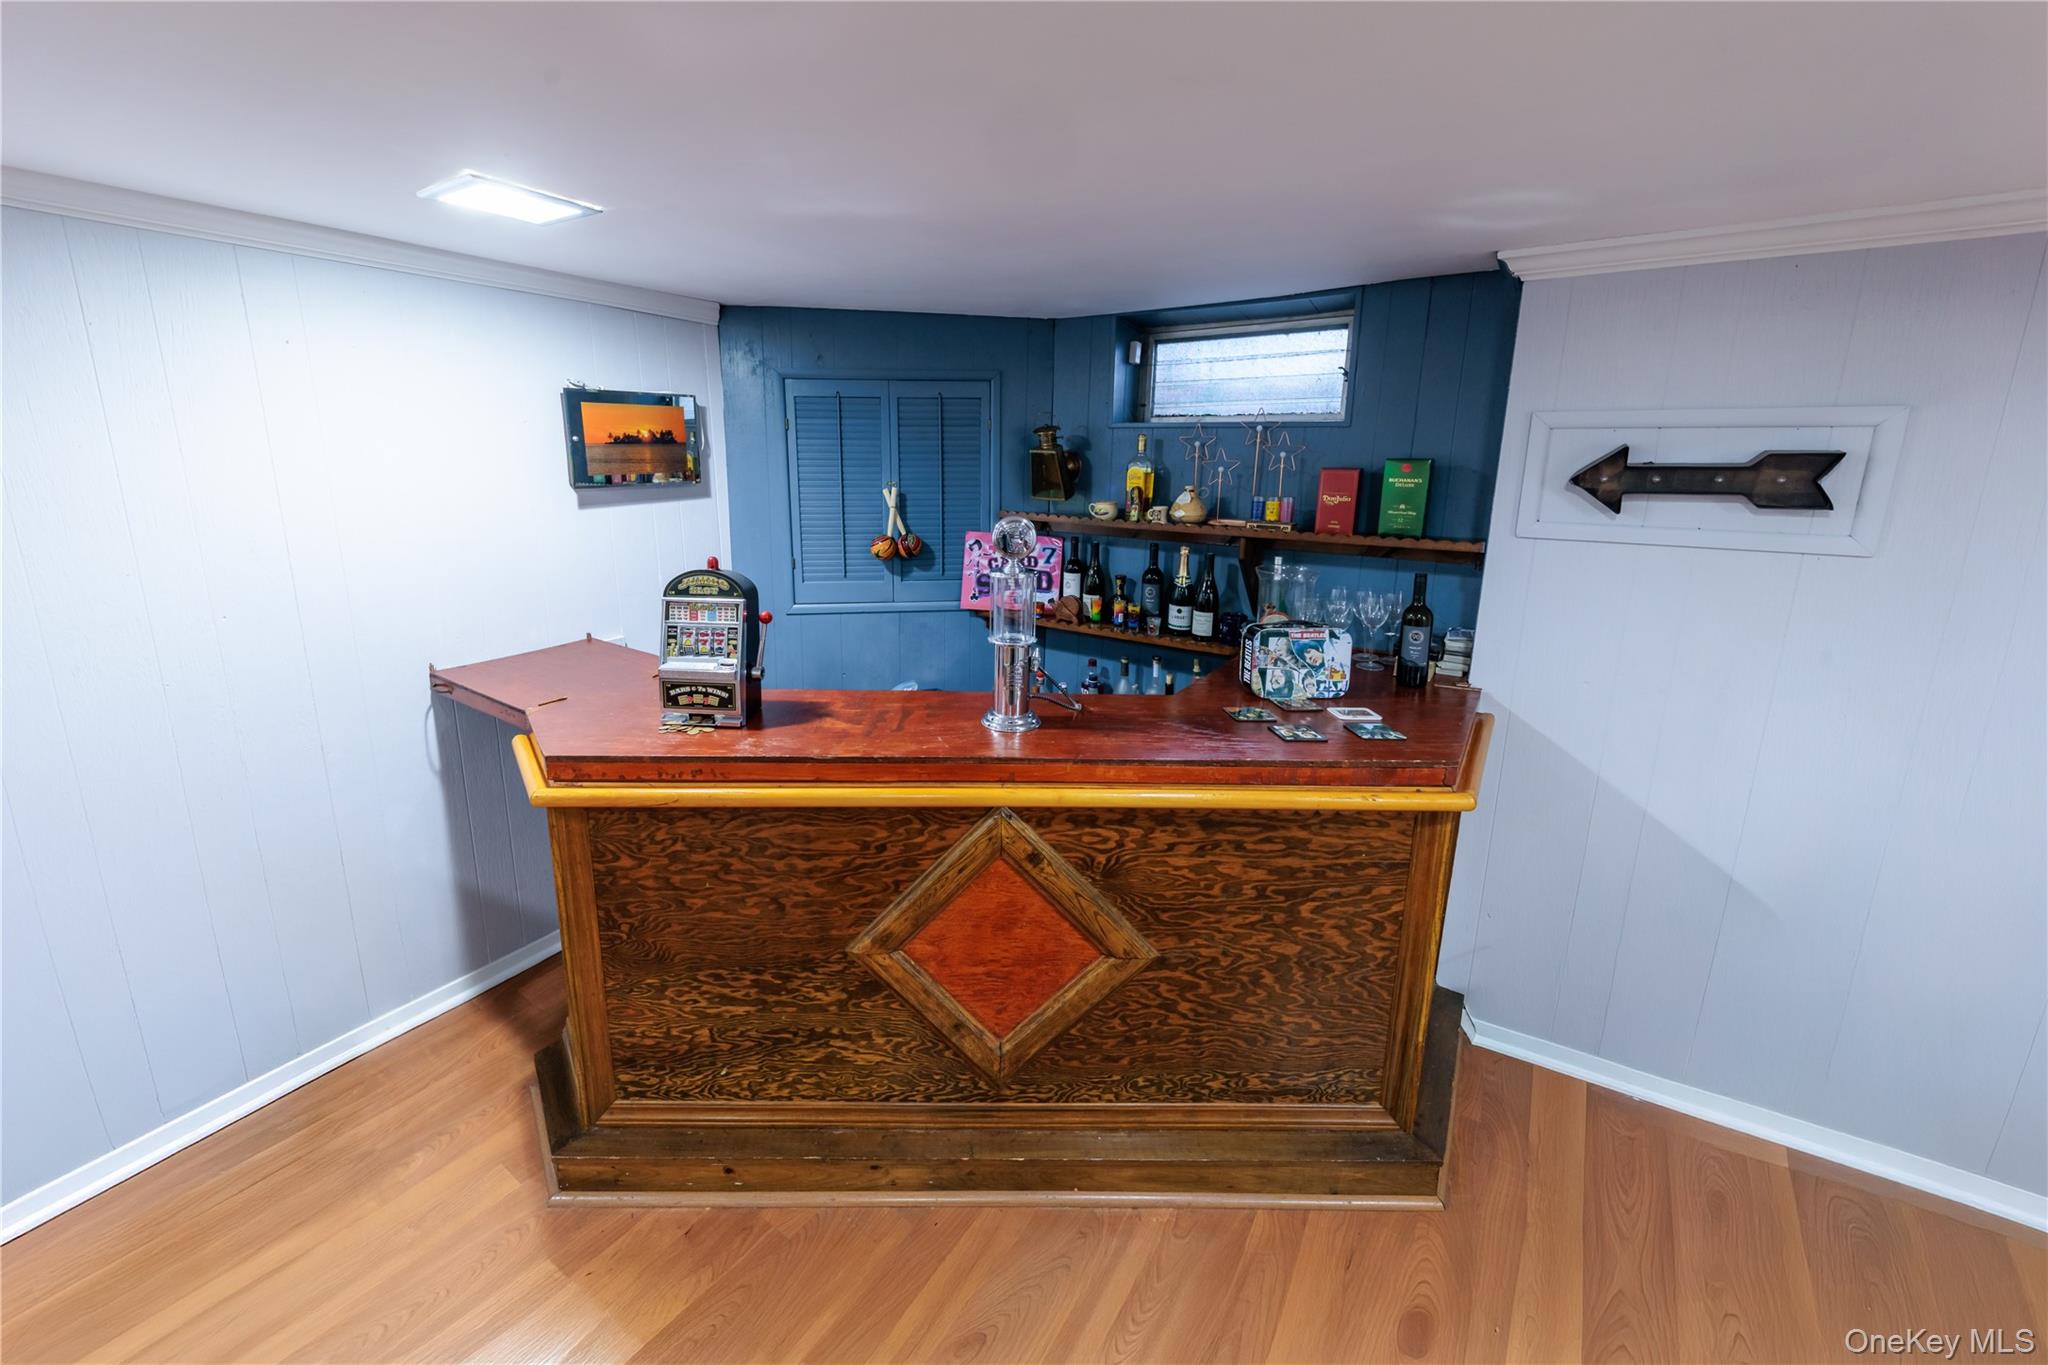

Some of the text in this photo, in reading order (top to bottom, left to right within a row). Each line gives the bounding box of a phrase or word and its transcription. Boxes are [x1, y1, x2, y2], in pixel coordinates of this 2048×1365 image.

[1042, 547, 1057, 564] 7
[1243, 639, 1253, 684] THE BEATLES
